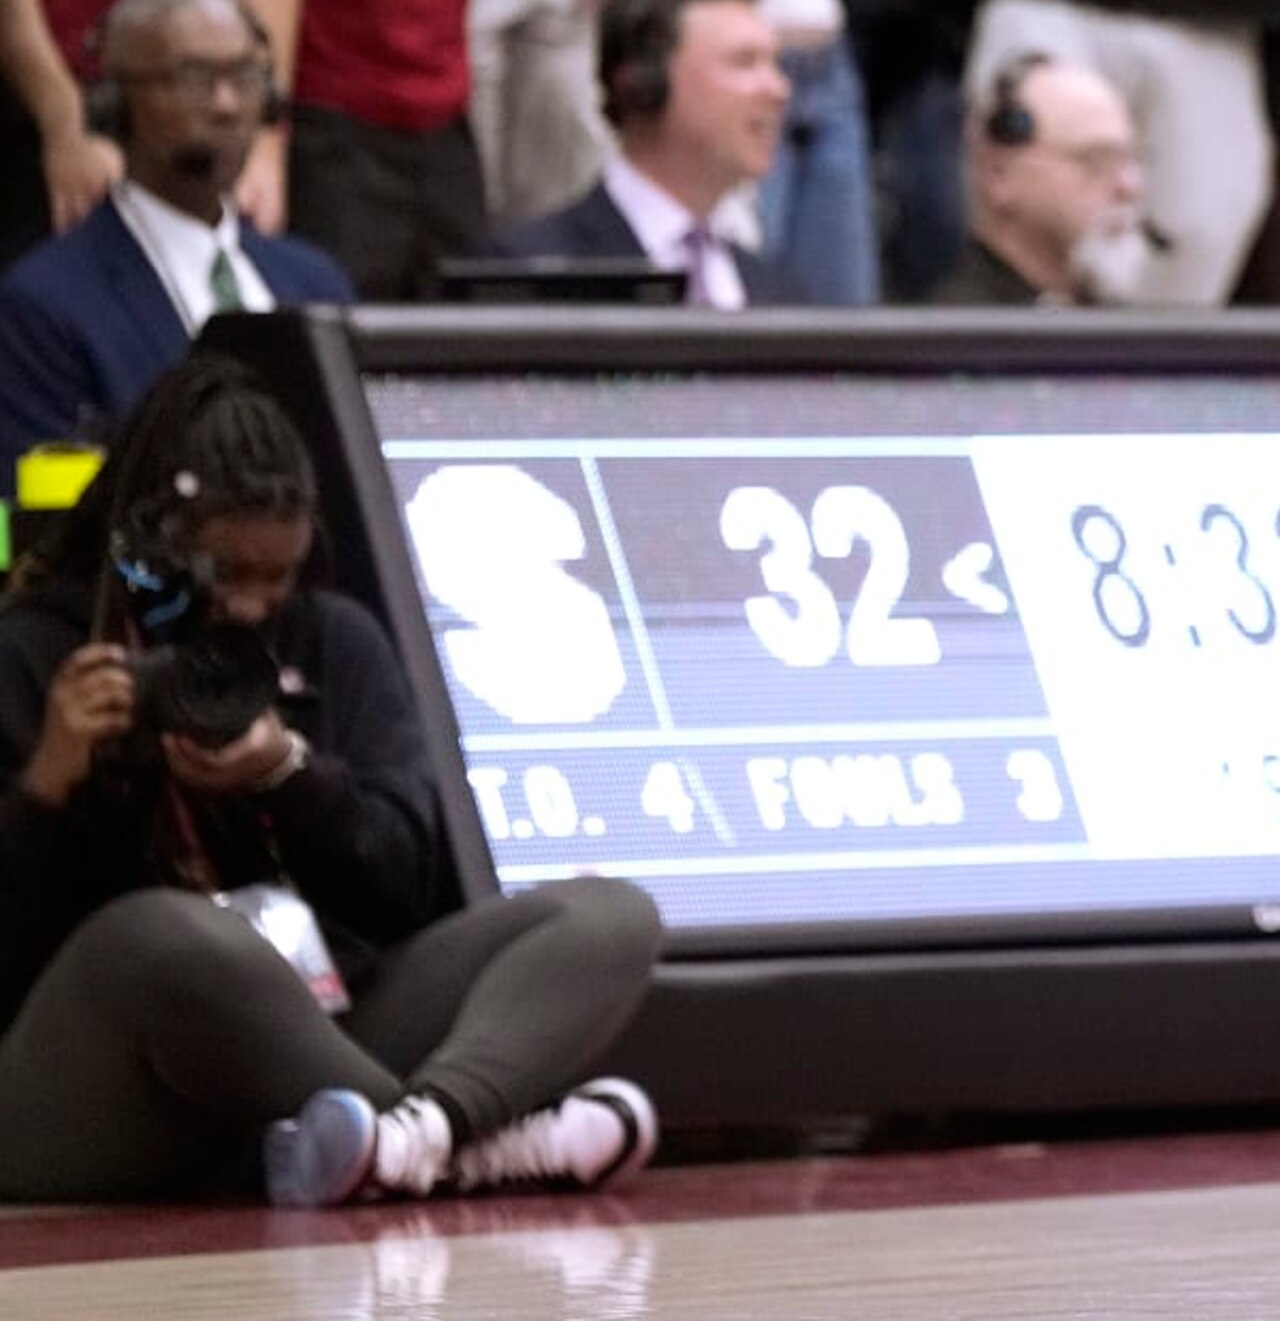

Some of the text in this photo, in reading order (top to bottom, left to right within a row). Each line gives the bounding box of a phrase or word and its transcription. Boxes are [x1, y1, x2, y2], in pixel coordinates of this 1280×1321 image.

[719, 485, 941, 668] 32
[642, 761, 693, 833] 4
[747, 749, 1062, 830] FOULS 3
